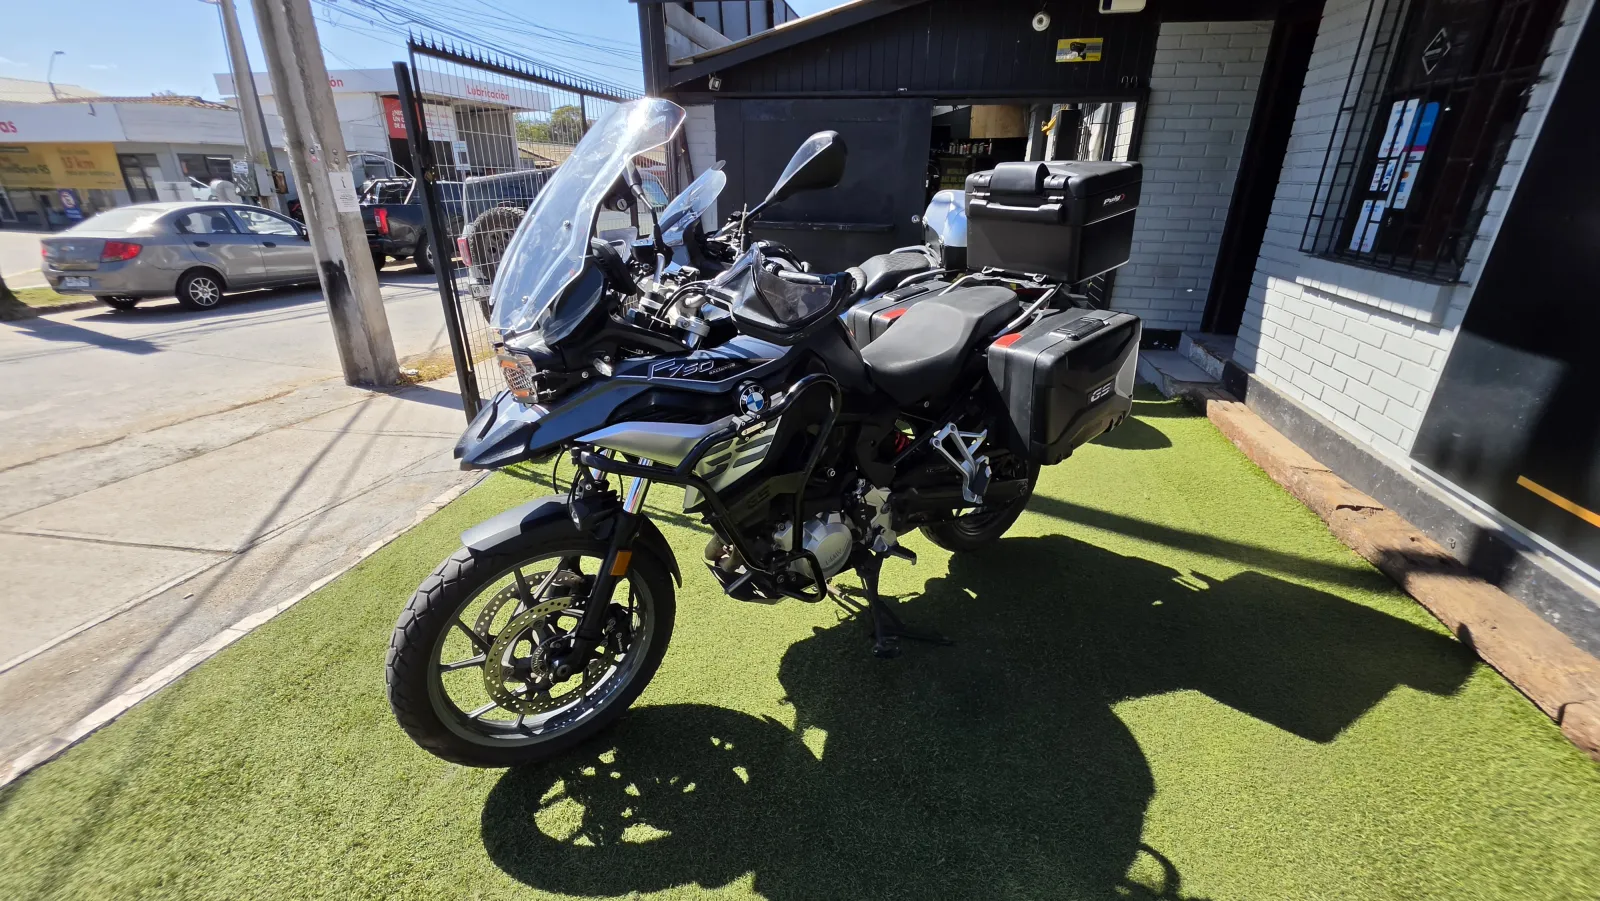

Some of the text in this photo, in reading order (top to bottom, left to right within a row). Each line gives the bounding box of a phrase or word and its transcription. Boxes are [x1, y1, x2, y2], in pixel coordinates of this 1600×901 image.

[466, 83, 510, 101] Lubricación
[741, 386, 765, 401] BMW
[1090, 382, 1111, 402] GS
